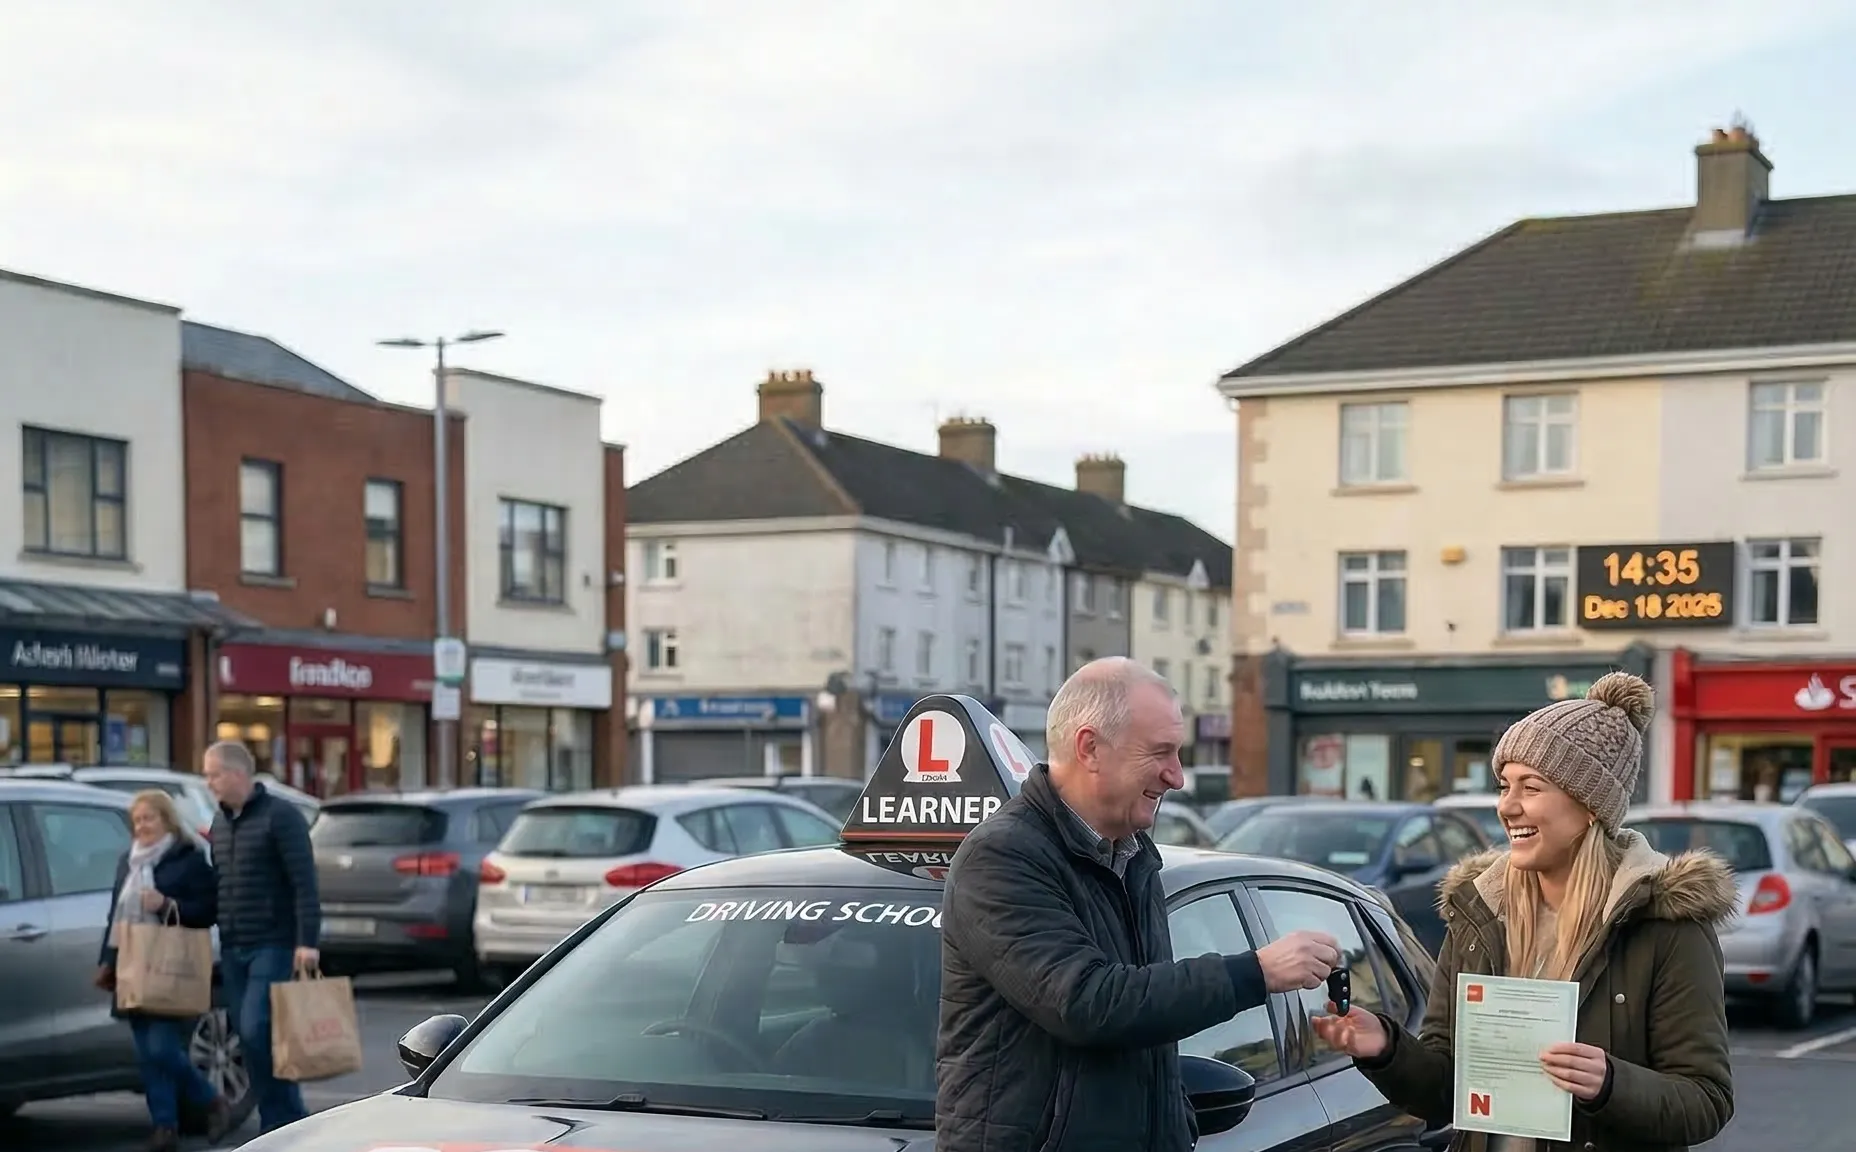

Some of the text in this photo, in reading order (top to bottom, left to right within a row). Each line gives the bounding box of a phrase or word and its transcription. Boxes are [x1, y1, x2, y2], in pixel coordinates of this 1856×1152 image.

[1603, 549, 1699, 586] 14:35
[918, 719, 949, 772] L
[685, 900, 832, 922] DRIVING
[1470, 1093, 1490, 1116] N
